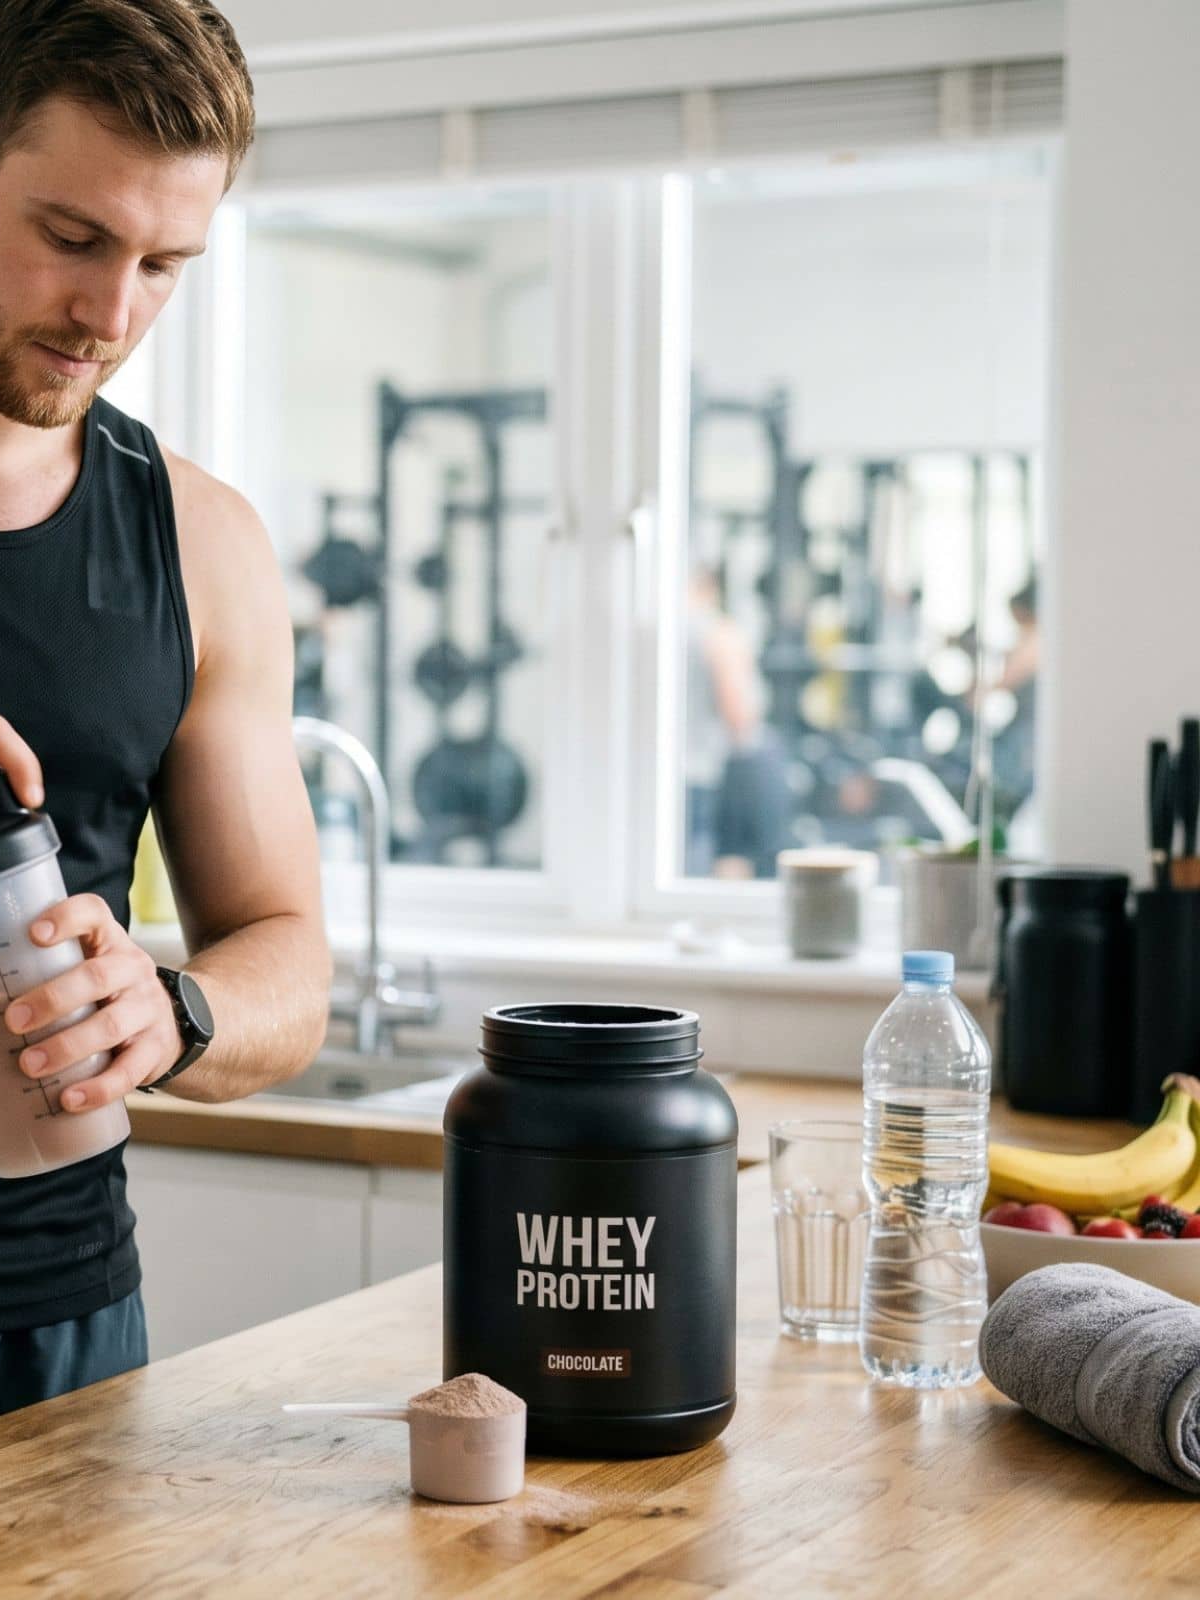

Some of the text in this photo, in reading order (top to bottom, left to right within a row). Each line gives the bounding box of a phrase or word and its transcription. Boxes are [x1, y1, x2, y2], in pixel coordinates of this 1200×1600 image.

[516, 1212, 657, 1268] WHEY
[516, 1268, 656, 1311] PROTEIN
[547, 1354, 623, 1372] CHOCOLATE
